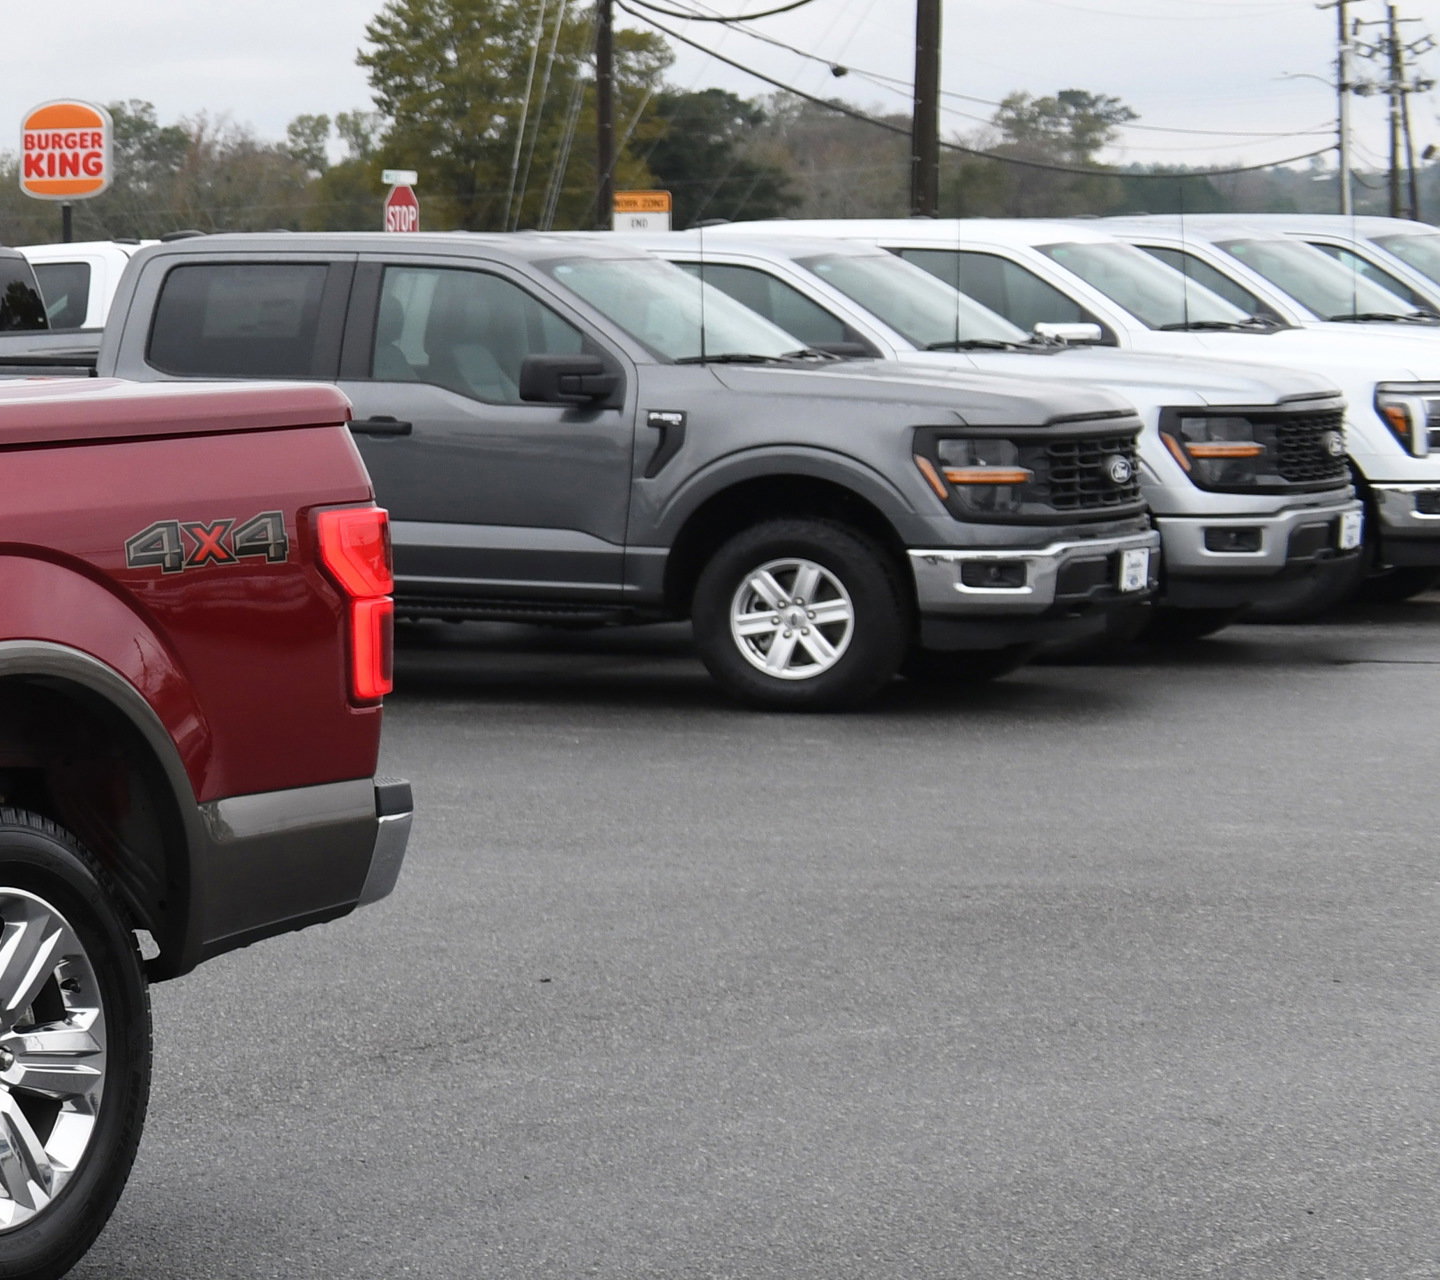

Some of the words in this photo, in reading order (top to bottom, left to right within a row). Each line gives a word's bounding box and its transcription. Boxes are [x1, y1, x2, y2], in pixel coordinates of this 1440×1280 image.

[24, 132, 103, 150] BURGER
[24, 152, 103, 178] KING
[387, 205, 417, 232] STOP
[630, 217, 648, 229] END
